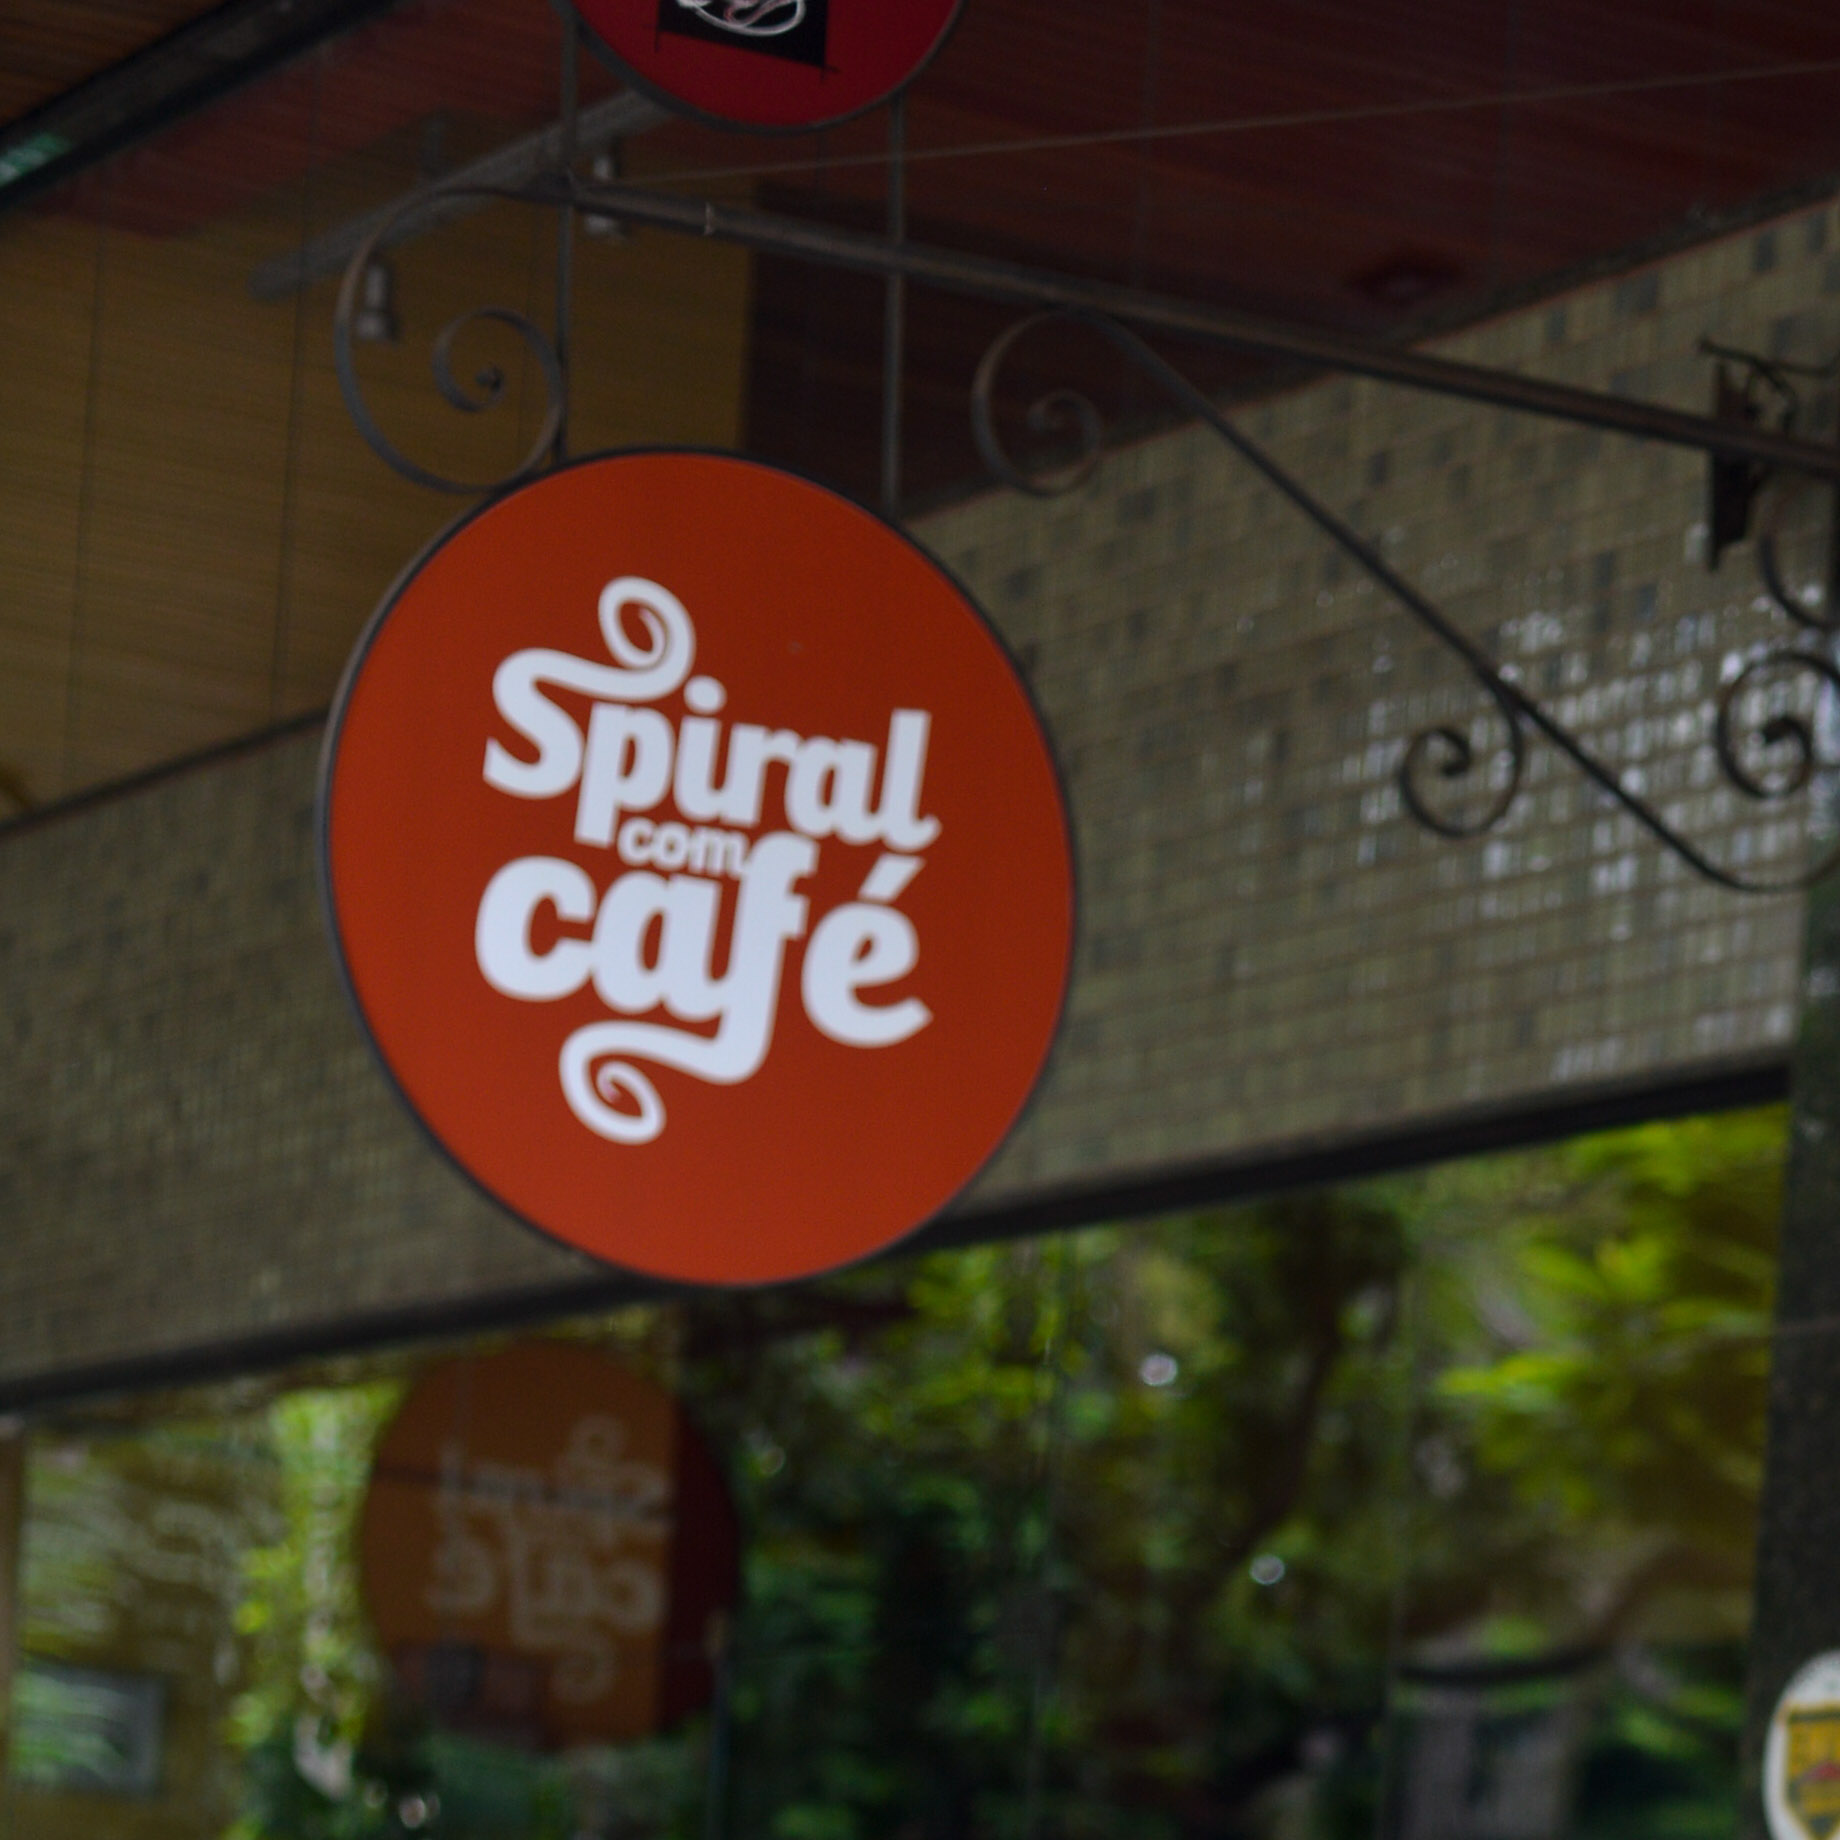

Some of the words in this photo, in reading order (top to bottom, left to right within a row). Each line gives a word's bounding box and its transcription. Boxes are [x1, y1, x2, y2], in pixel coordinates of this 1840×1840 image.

[482, 576, 941, 850] Spiral
[617, 815, 748, 881] com
[474, 831, 933, 1145] café
